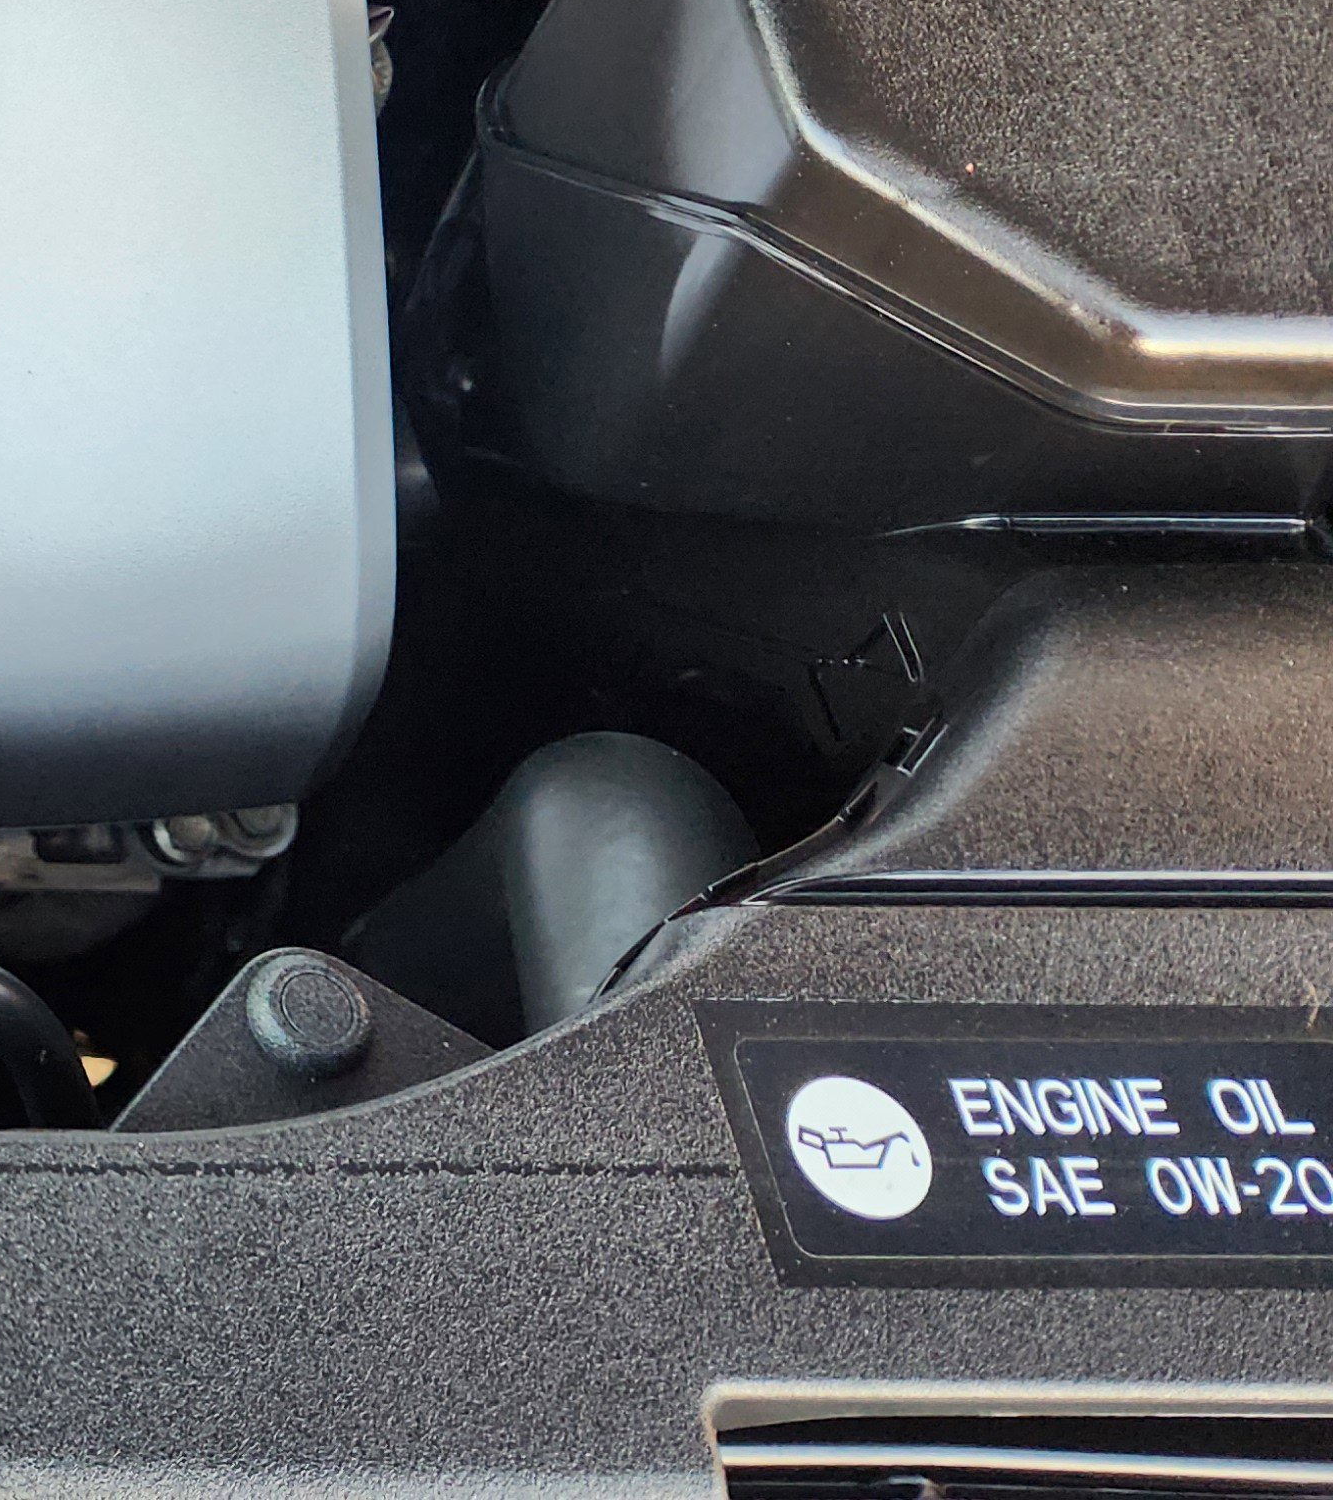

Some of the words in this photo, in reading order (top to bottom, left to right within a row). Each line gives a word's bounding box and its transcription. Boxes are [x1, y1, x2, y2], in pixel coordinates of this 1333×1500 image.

[947, 1077, 1181, 1137] ENGINE
[1207, 1077, 1316, 1136] OIL
[981, 1156, 1117, 1217] SAE
[1146, 1156, 1333, 1217] 0W-20
